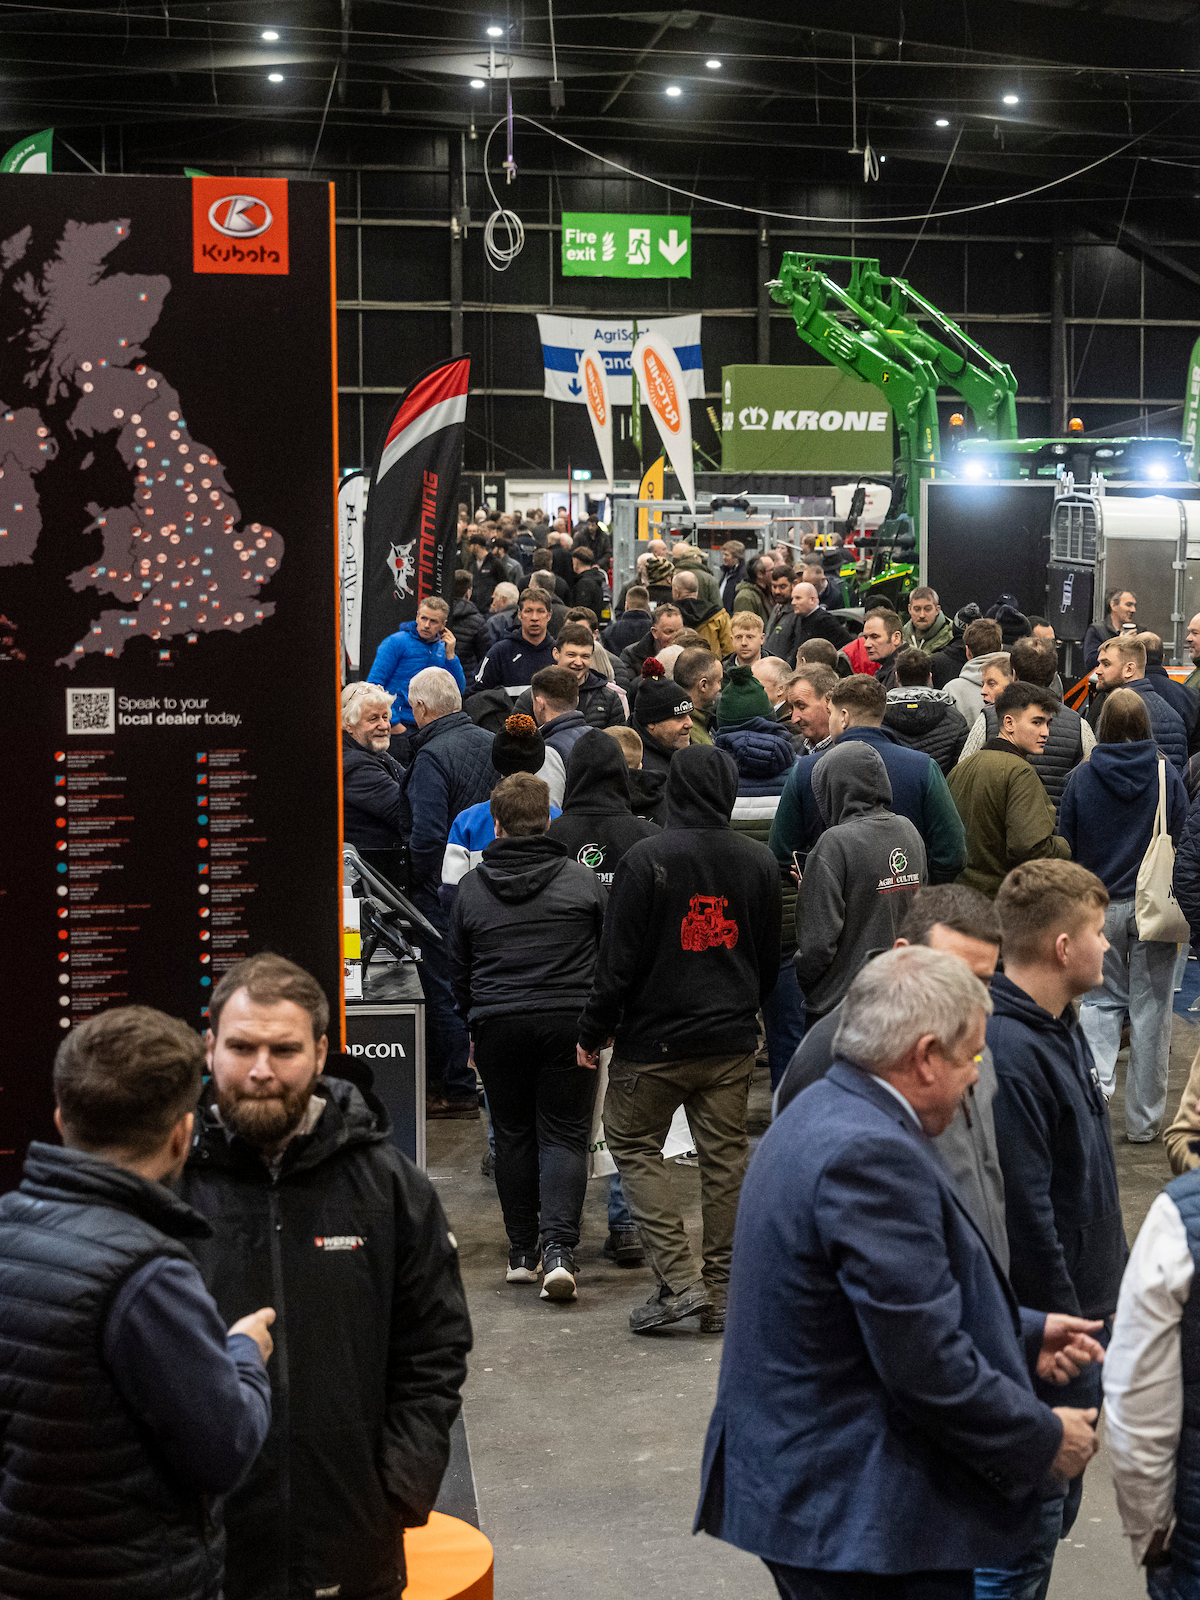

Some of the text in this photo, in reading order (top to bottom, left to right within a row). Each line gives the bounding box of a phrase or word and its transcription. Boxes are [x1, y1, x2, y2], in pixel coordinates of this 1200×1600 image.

[565, 228, 597, 244] Fire
[202, 244, 280, 262] Kubota
[566, 246, 596, 261] exit
[771, 410, 889, 432] KRONE
[436, 543, 444, 594] LIMITED
[118, 696, 209, 712] Speak to your
[118, 711, 243, 727] local dealer today.
